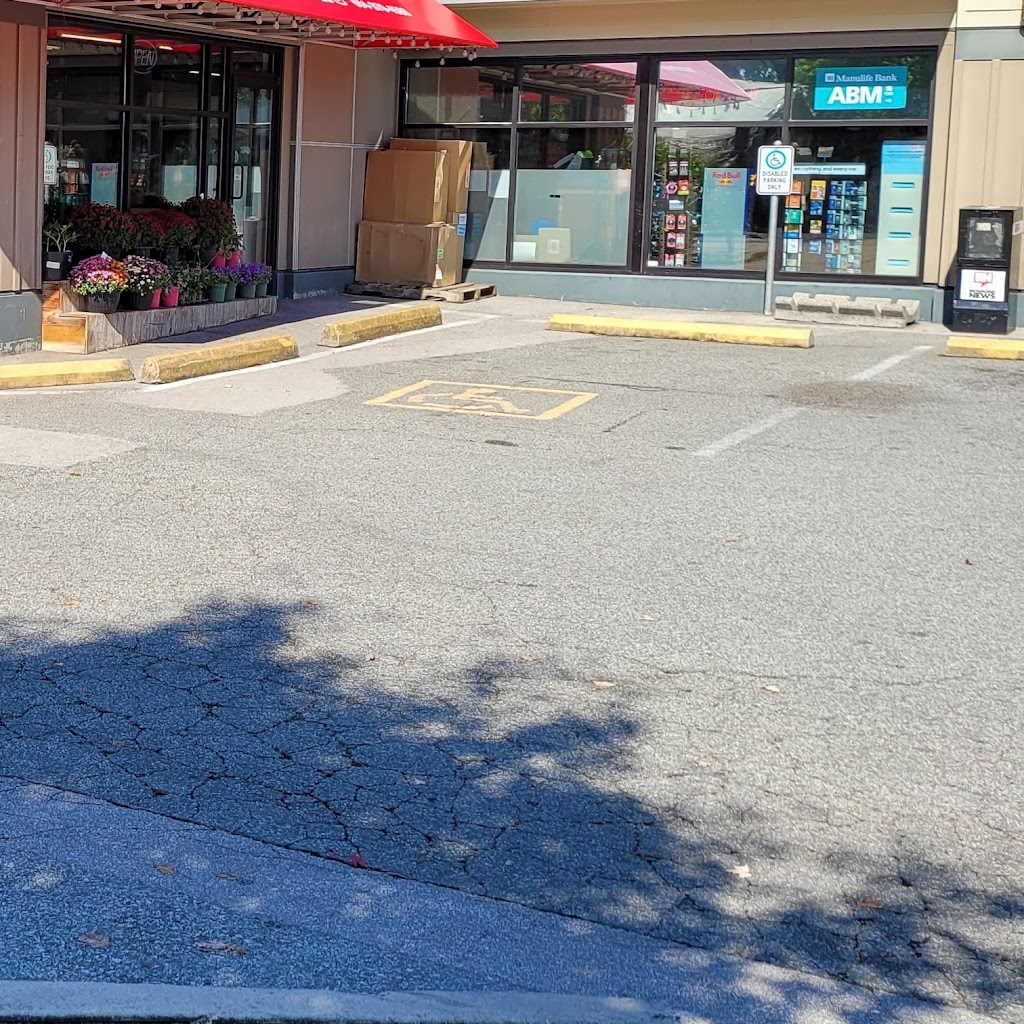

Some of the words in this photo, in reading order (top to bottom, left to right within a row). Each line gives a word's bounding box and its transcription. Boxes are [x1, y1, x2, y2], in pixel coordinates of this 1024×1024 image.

[836, 73, 874, 83] Manulife
[874, 73, 898, 82] Bank
[827, 85, 883, 105] ABM
[712, 171, 727, 179] Red
[727, 171, 742, 179] Bull
